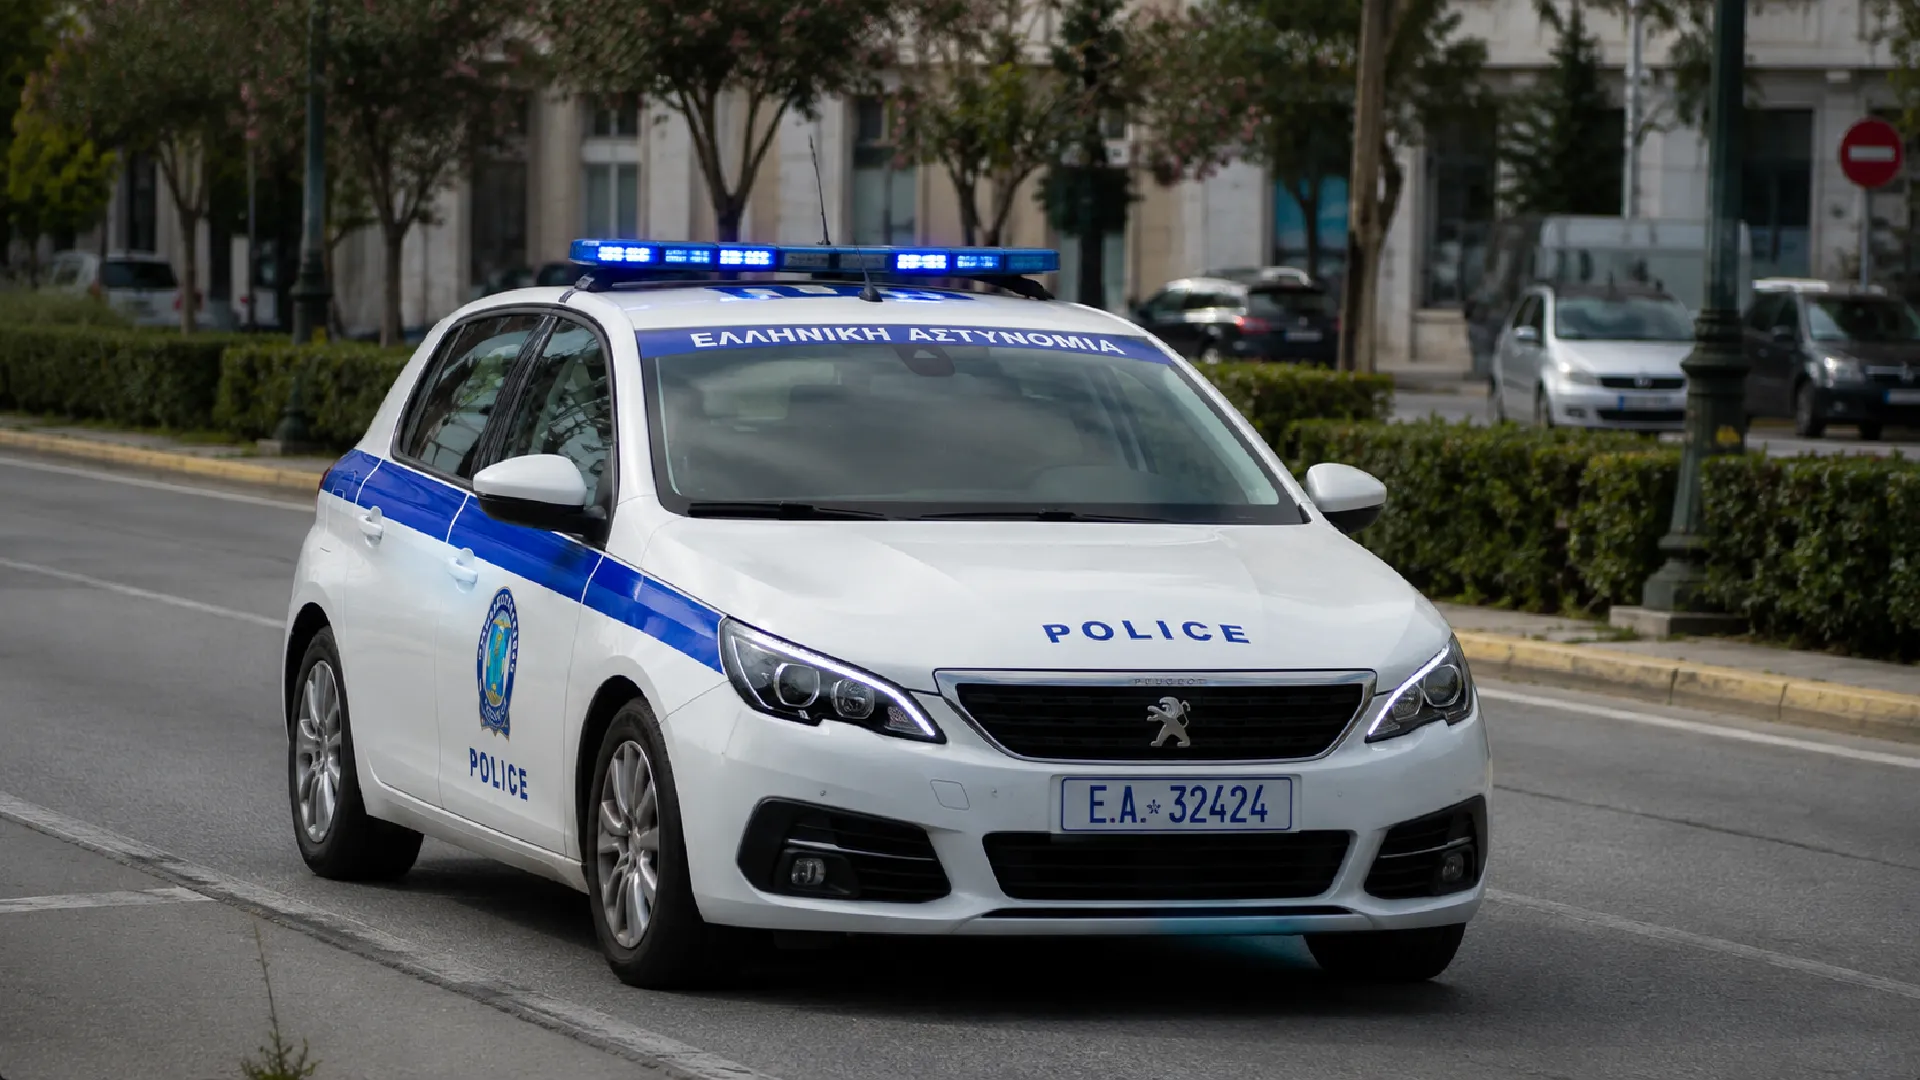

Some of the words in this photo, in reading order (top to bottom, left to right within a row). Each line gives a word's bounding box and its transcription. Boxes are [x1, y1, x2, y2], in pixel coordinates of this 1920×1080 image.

[690, 327, 892, 348] ΕΛΛΗΝΙΚΗ
[909, 327, 1127, 355] ΑΣΤΥΝΟΜΙΑ
[1042, 620, 1251, 644] POLICE
[469, 747, 528, 801] POLICE
[1169, 785, 1268, 823] 32424
